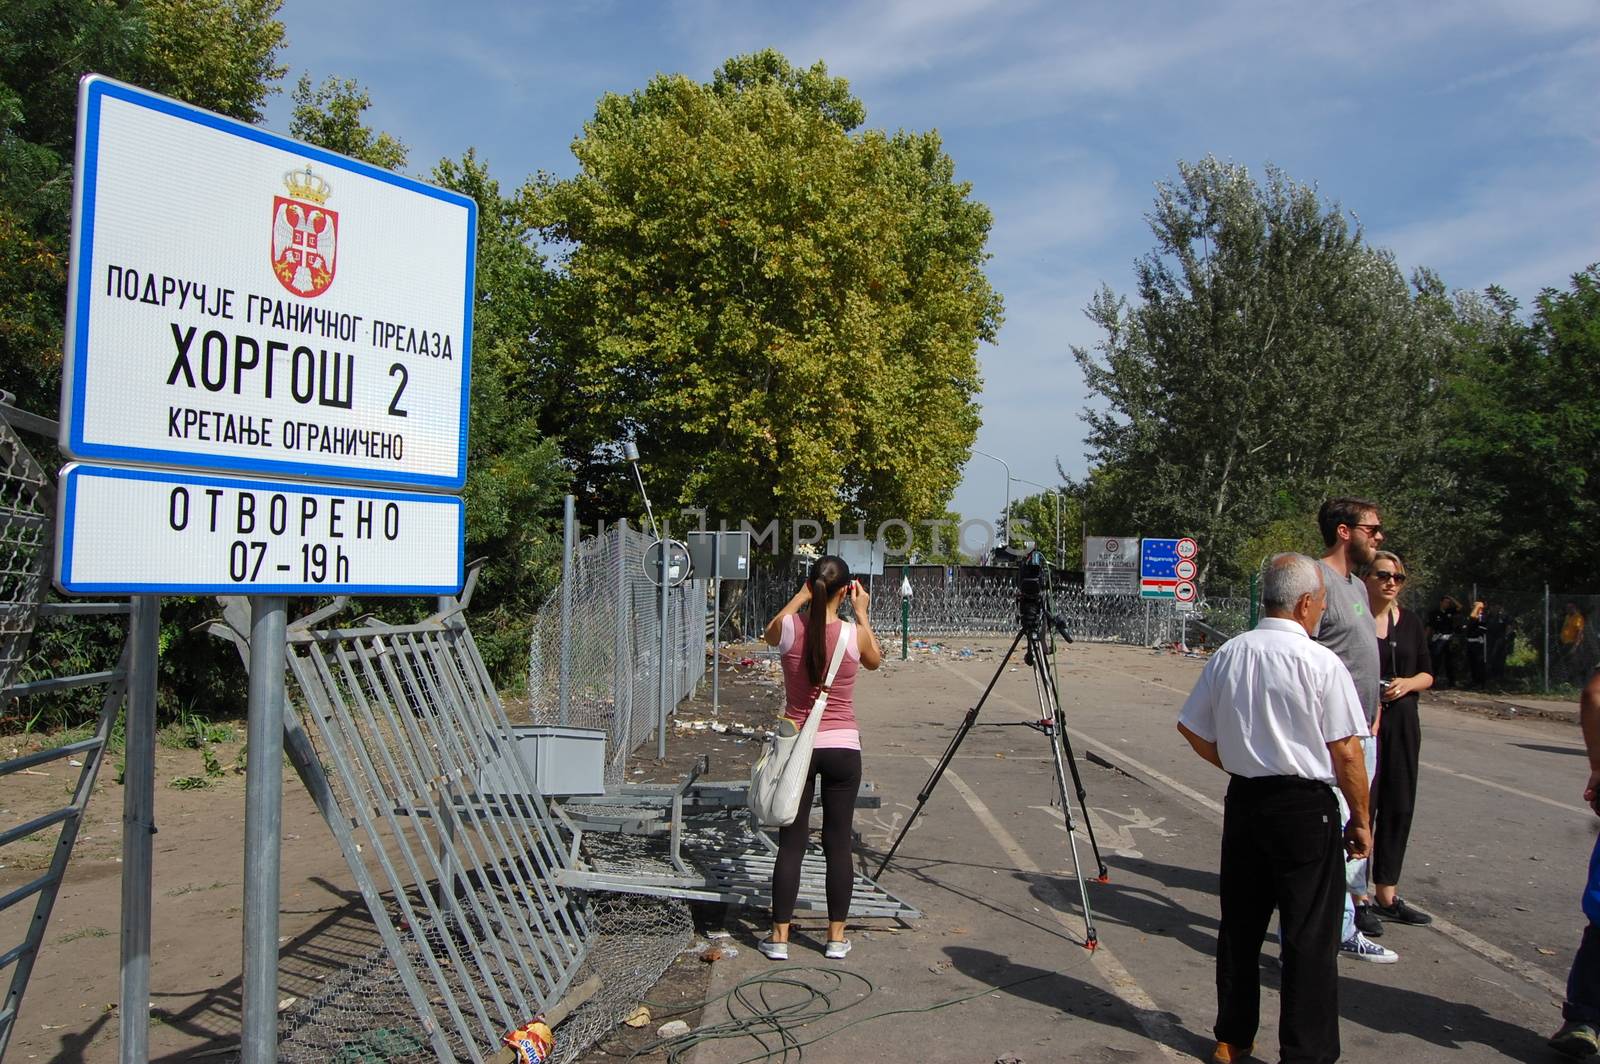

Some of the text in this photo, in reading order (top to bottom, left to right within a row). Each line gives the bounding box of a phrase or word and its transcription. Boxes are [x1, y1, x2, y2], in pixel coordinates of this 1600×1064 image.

[106, 264, 453, 361] ПОДРУЧЈЕ ГРАНИЧНОГ ПРЕЛАЗА
[166, 322, 409, 418] ХОРГОШ 2
[168, 406, 404, 462] КРЕТАЊЕ ОГРАНИЧЕНО
[169, 486, 400, 541] ОТВОРЕНО
